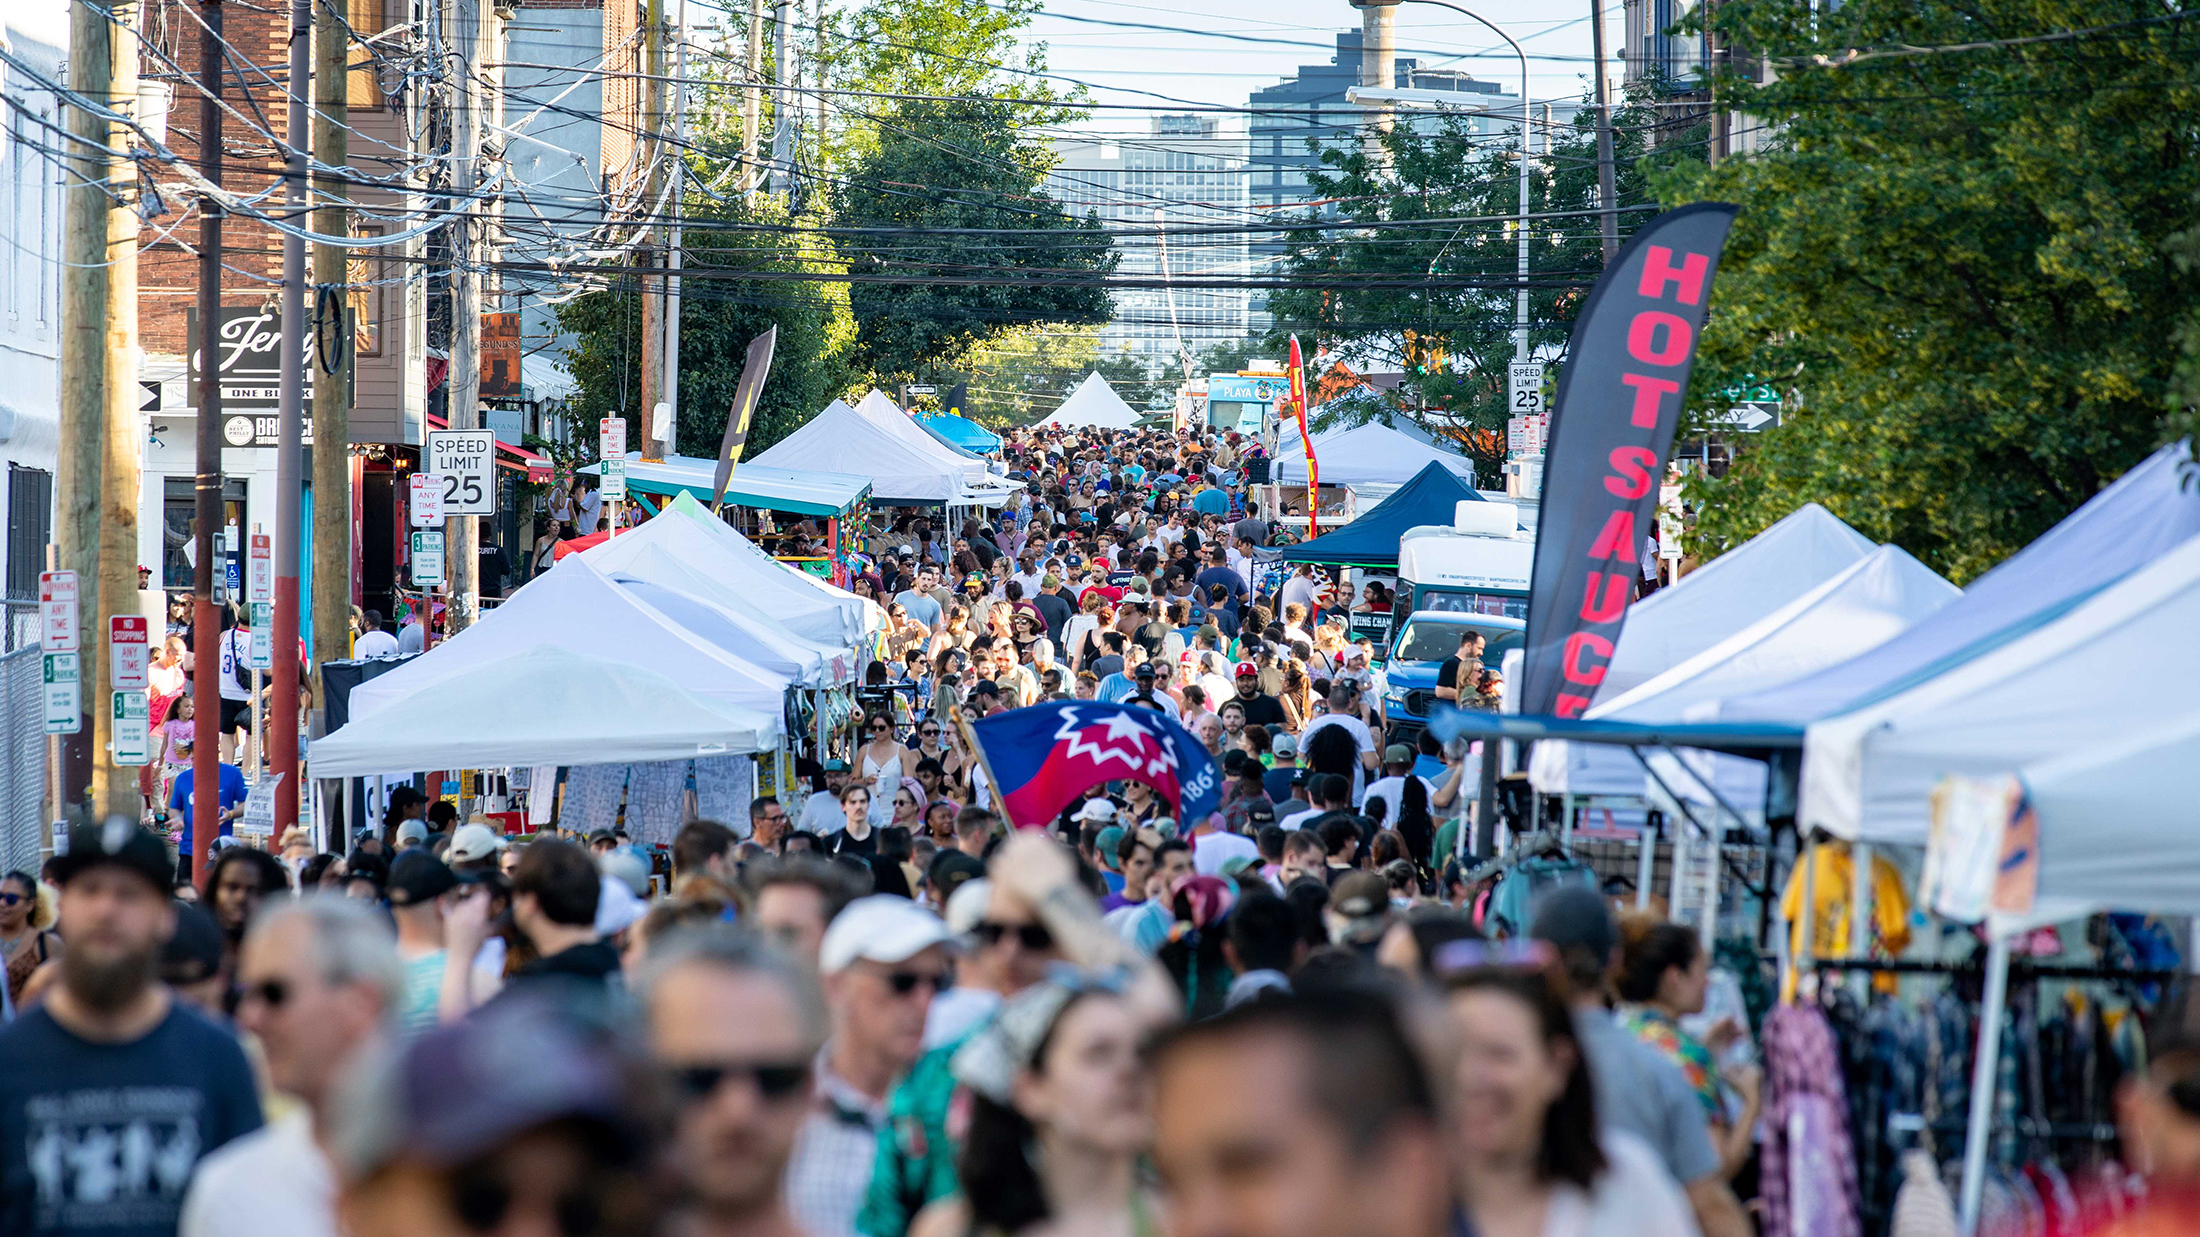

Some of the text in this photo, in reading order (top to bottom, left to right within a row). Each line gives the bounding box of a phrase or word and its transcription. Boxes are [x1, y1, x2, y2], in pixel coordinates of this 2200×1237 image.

[1621, 245, 1710, 430] HOT
[1513, 368, 1540, 377] SPEED
[1516, 379, 1538, 387] LIMIT
[231, 389, 310, 397] ONE BLK
[1224, 386, 1251, 398] PLAYA
[1516, 390, 1539, 407] 25
[435, 440, 487, 453] SPEED
[440, 456, 481, 469] LIMIT
[443, 475, 483, 505] 25
[418, 502, 437, 510] TIME
[51, 604, 65, 615] ANY
[51, 619, 68, 630] TIME
[123, 619, 134, 629] NO
[1353, 616, 1371, 626] WING
[113, 630, 146, 641] STOPPING
[121, 647, 138, 658] ANY
[121, 659, 140, 671] TIME
[116, 696, 122, 715] 3
[124, 707, 147, 716] PARKING
